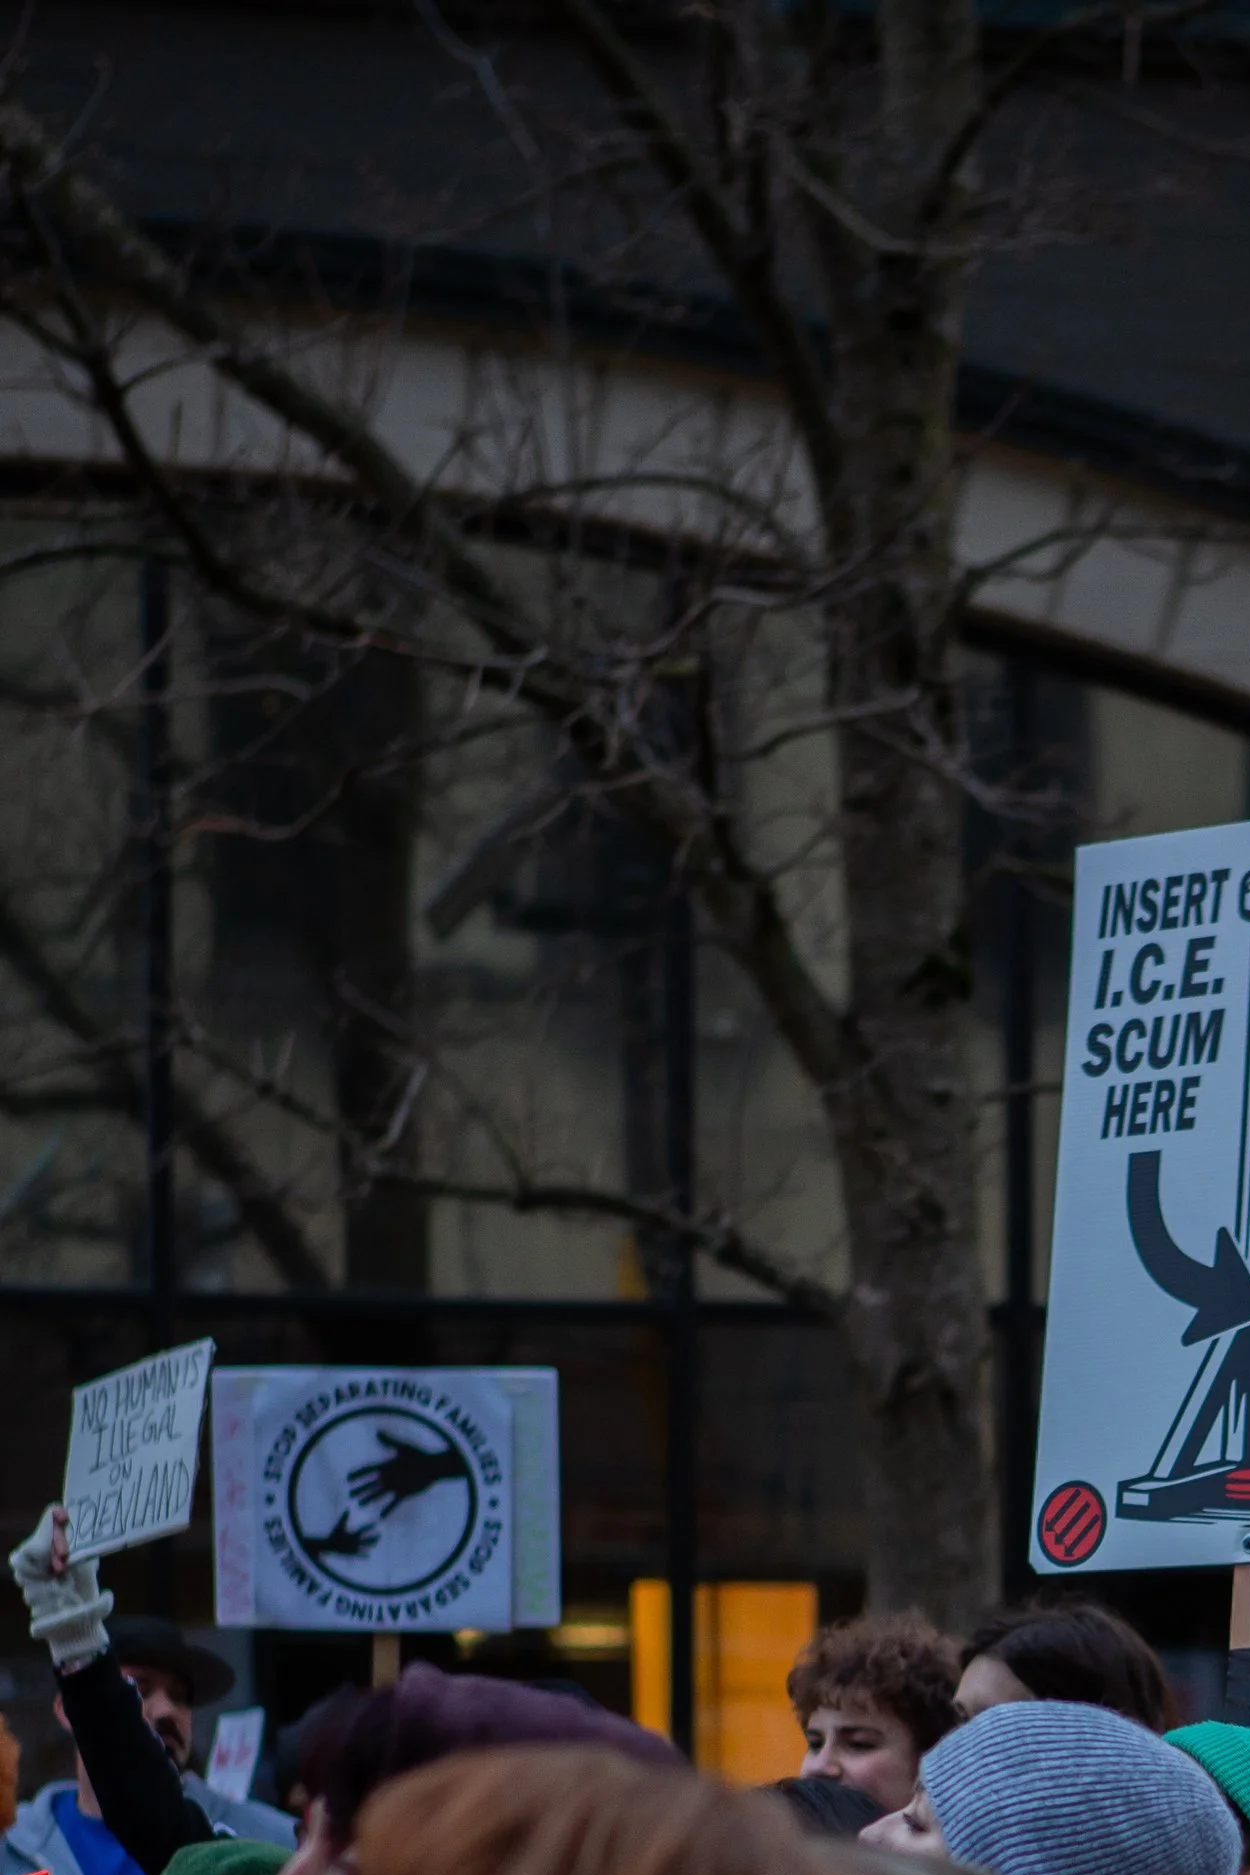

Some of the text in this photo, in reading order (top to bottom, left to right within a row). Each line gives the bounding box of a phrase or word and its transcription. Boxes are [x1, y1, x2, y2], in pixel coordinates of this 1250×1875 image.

[1098, 868, 1231, 939] INSERT
[1094, 936, 1225, 1010] I.C.E.
[1081, 1008, 1226, 1078] SCUM
[1100, 1075, 1202, 1140] HERE
[82, 1350, 200, 1430] NO HUMAN IS
[88, 1403, 182, 1475] ILLEGAL
[109, 1458, 132, 1486] ON
[134, 1459, 190, 1528] LAND
